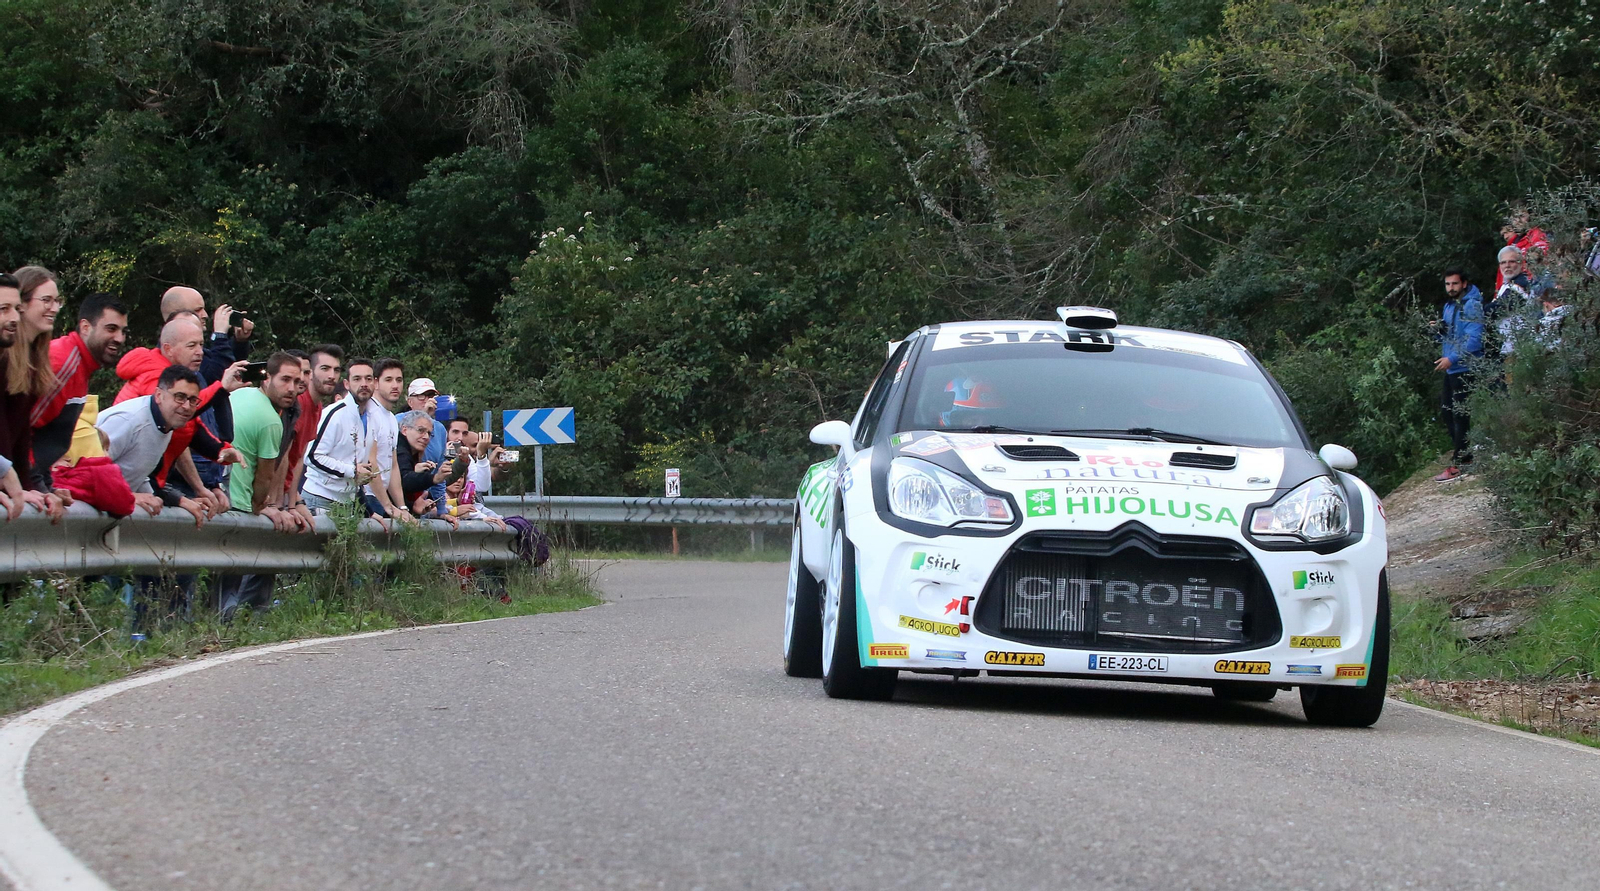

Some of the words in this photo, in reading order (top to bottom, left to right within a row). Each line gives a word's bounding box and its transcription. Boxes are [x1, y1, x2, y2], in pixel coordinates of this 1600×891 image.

[960, 330, 1146, 346] STARK
[1043, 465, 1212, 486] natura
[1066, 486, 1139, 495] PATATAS
[1066, 496, 1239, 527] HIJOLUSA
[927, 556, 961, 570] Stick
[1309, 571, 1334, 583] Stick
[1300, 637, 1341, 648] AGROLUGO
[871, 646, 907, 656] PIRELLI
[986, 652, 1045, 665] GALFER
[1099, 656, 1164, 671] EE-223-CL
[1215, 660, 1271, 674] GALFER
[1336, 666, 1365, 677] PIRELLI
